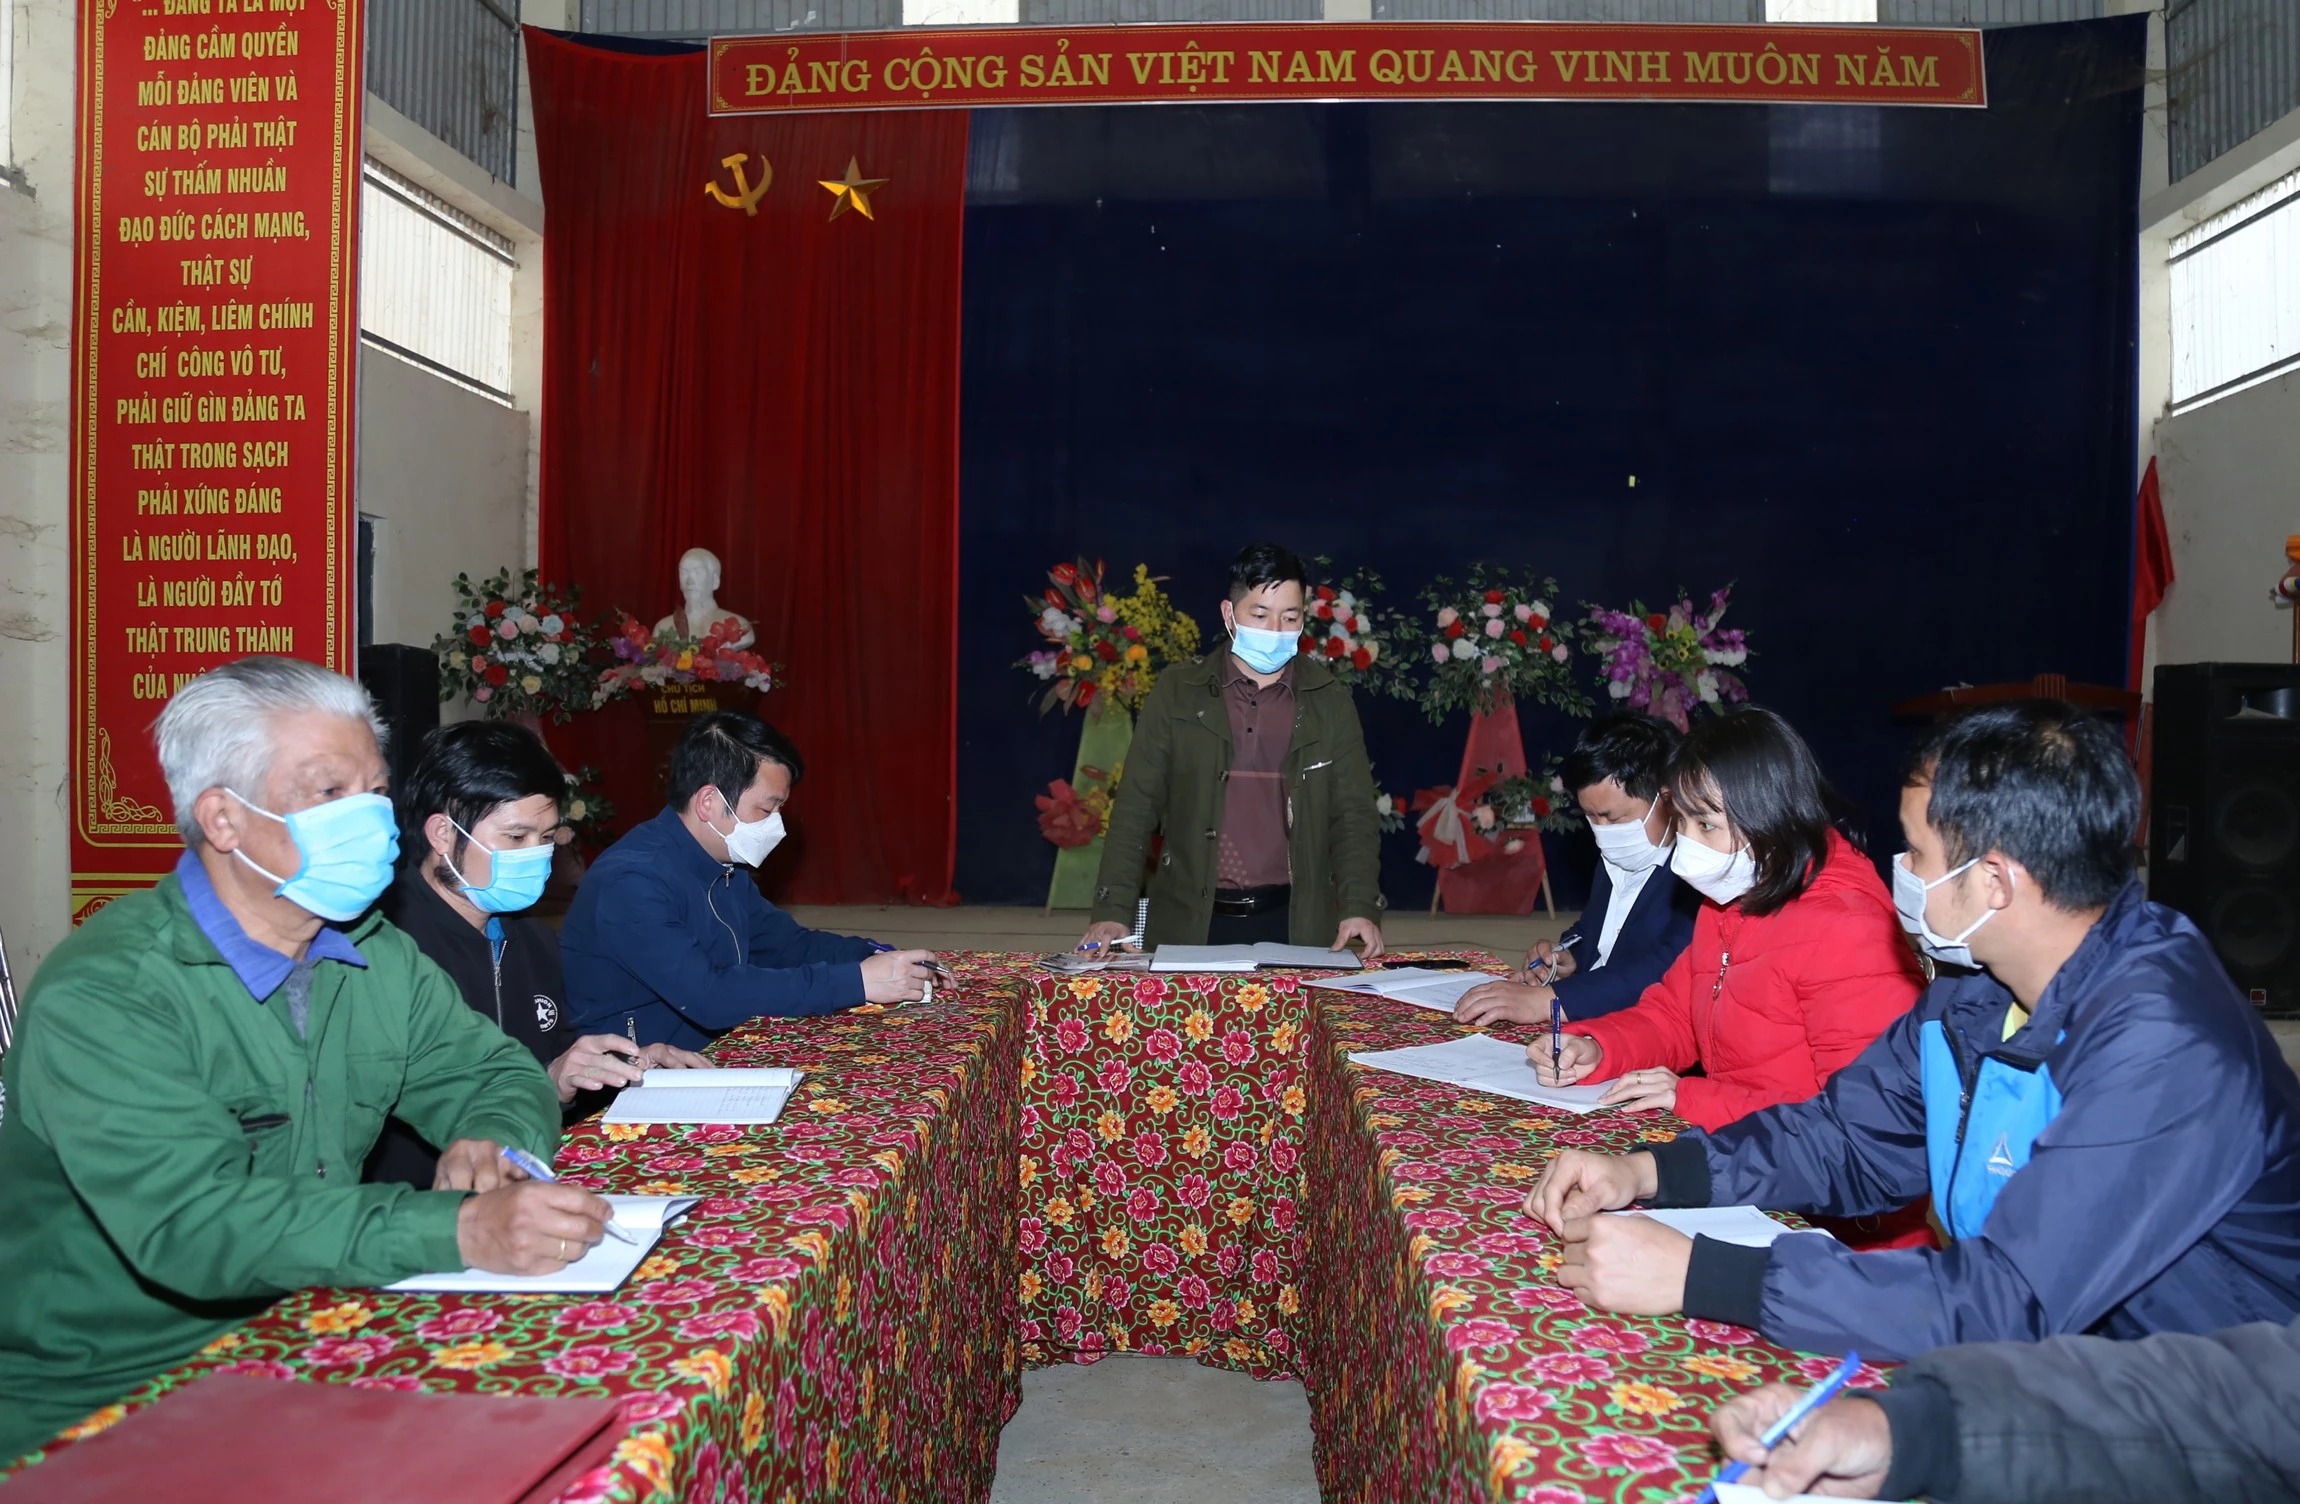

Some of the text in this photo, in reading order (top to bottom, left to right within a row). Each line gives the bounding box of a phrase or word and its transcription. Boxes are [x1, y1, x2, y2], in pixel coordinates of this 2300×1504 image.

[143, 22, 298, 61] ĐẢNG CẦM QUYỀN
[746, 38, 1940, 98] ĐẢNG CỘNG SẢN VIỆT NAM QUANG VINH MUÔN NĂM
[138, 69, 298, 106] MỖI ĐẢNG VIÊN VÀ
[136, 115, 297, 156] CÁN BỘ PHẢI THẬT
[144, 157, 286, 202] SỰ THẤM NHUẦN
[119, 208, 310, 248] ĐẠO ĐỨC CÁCH MẠNG,
[181, 253, 253, 291] THẬT SỰ
[112, 297, 313, 336] CẦN, KIỆM, LIÊM CHÍNH
[137, 344, 286, 379] CHÍ CÔNG VÔ TƯ,
[117, 388, 306, 424] PHẢI GIỮ GÌN ĐẢNG TA
[132, 438, 288, 475] THẬT TRONG SẠCH
[138, 482, 281, 515] PHẢI XỨNG ĐÁNG
[123, 529, 297, 564] LÀ NGƯỜI LÃNH ĐẠO,
[138, 571, 282, 607] LÀ NGƯỜI ĐẦY TỚ
[126, 620, 293, 658] THẬT TRUNG THÀNH
[133, 665, 167, 699] CỦA
[690, 698, 717, 712] MINH
